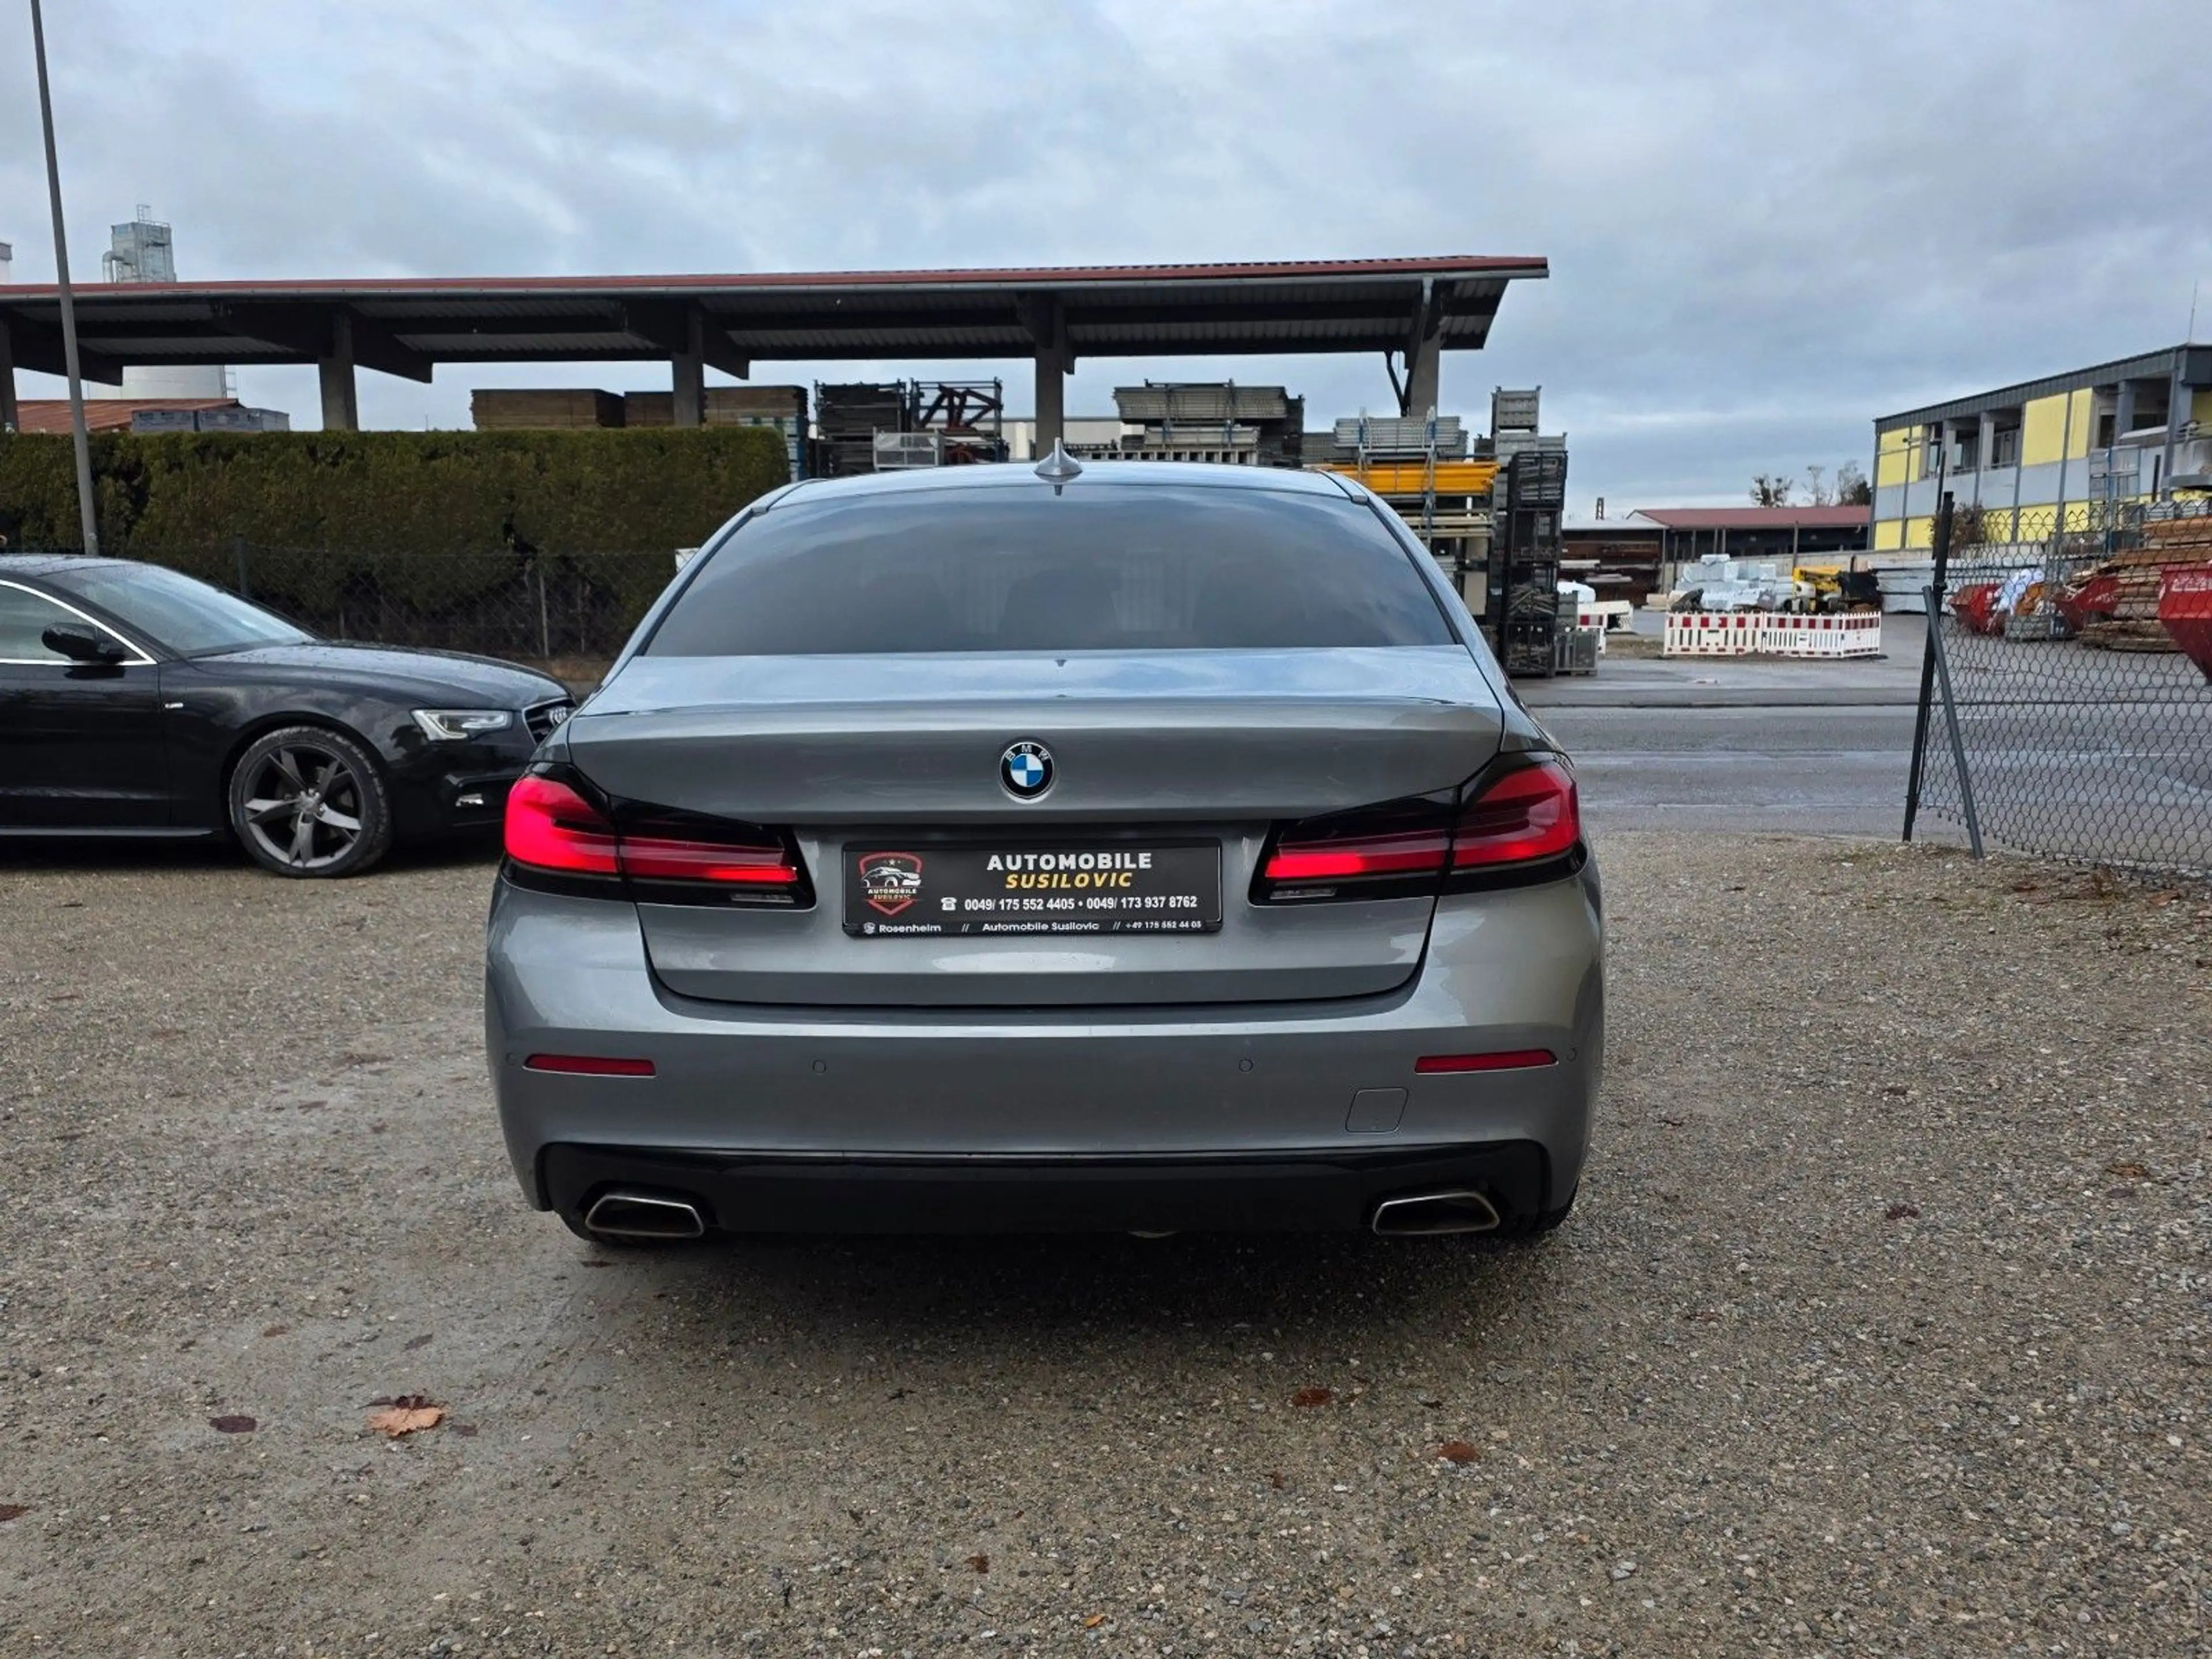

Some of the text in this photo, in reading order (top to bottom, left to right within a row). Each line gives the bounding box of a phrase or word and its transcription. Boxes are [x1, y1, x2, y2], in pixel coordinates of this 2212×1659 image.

[1005, 745, 1050, 762] BMW
[987, 853, 1152, 870] AUTOMOBILE
[1006, 872, 1132, 888] SUSILOVIC
[964, 896, 1198, 911] 0049/ 175 552 4405 0049/ 173 937 8762
[982, 922, 1049, 931] Automobile
[1052, 921, 1100, 930] Susilovic
